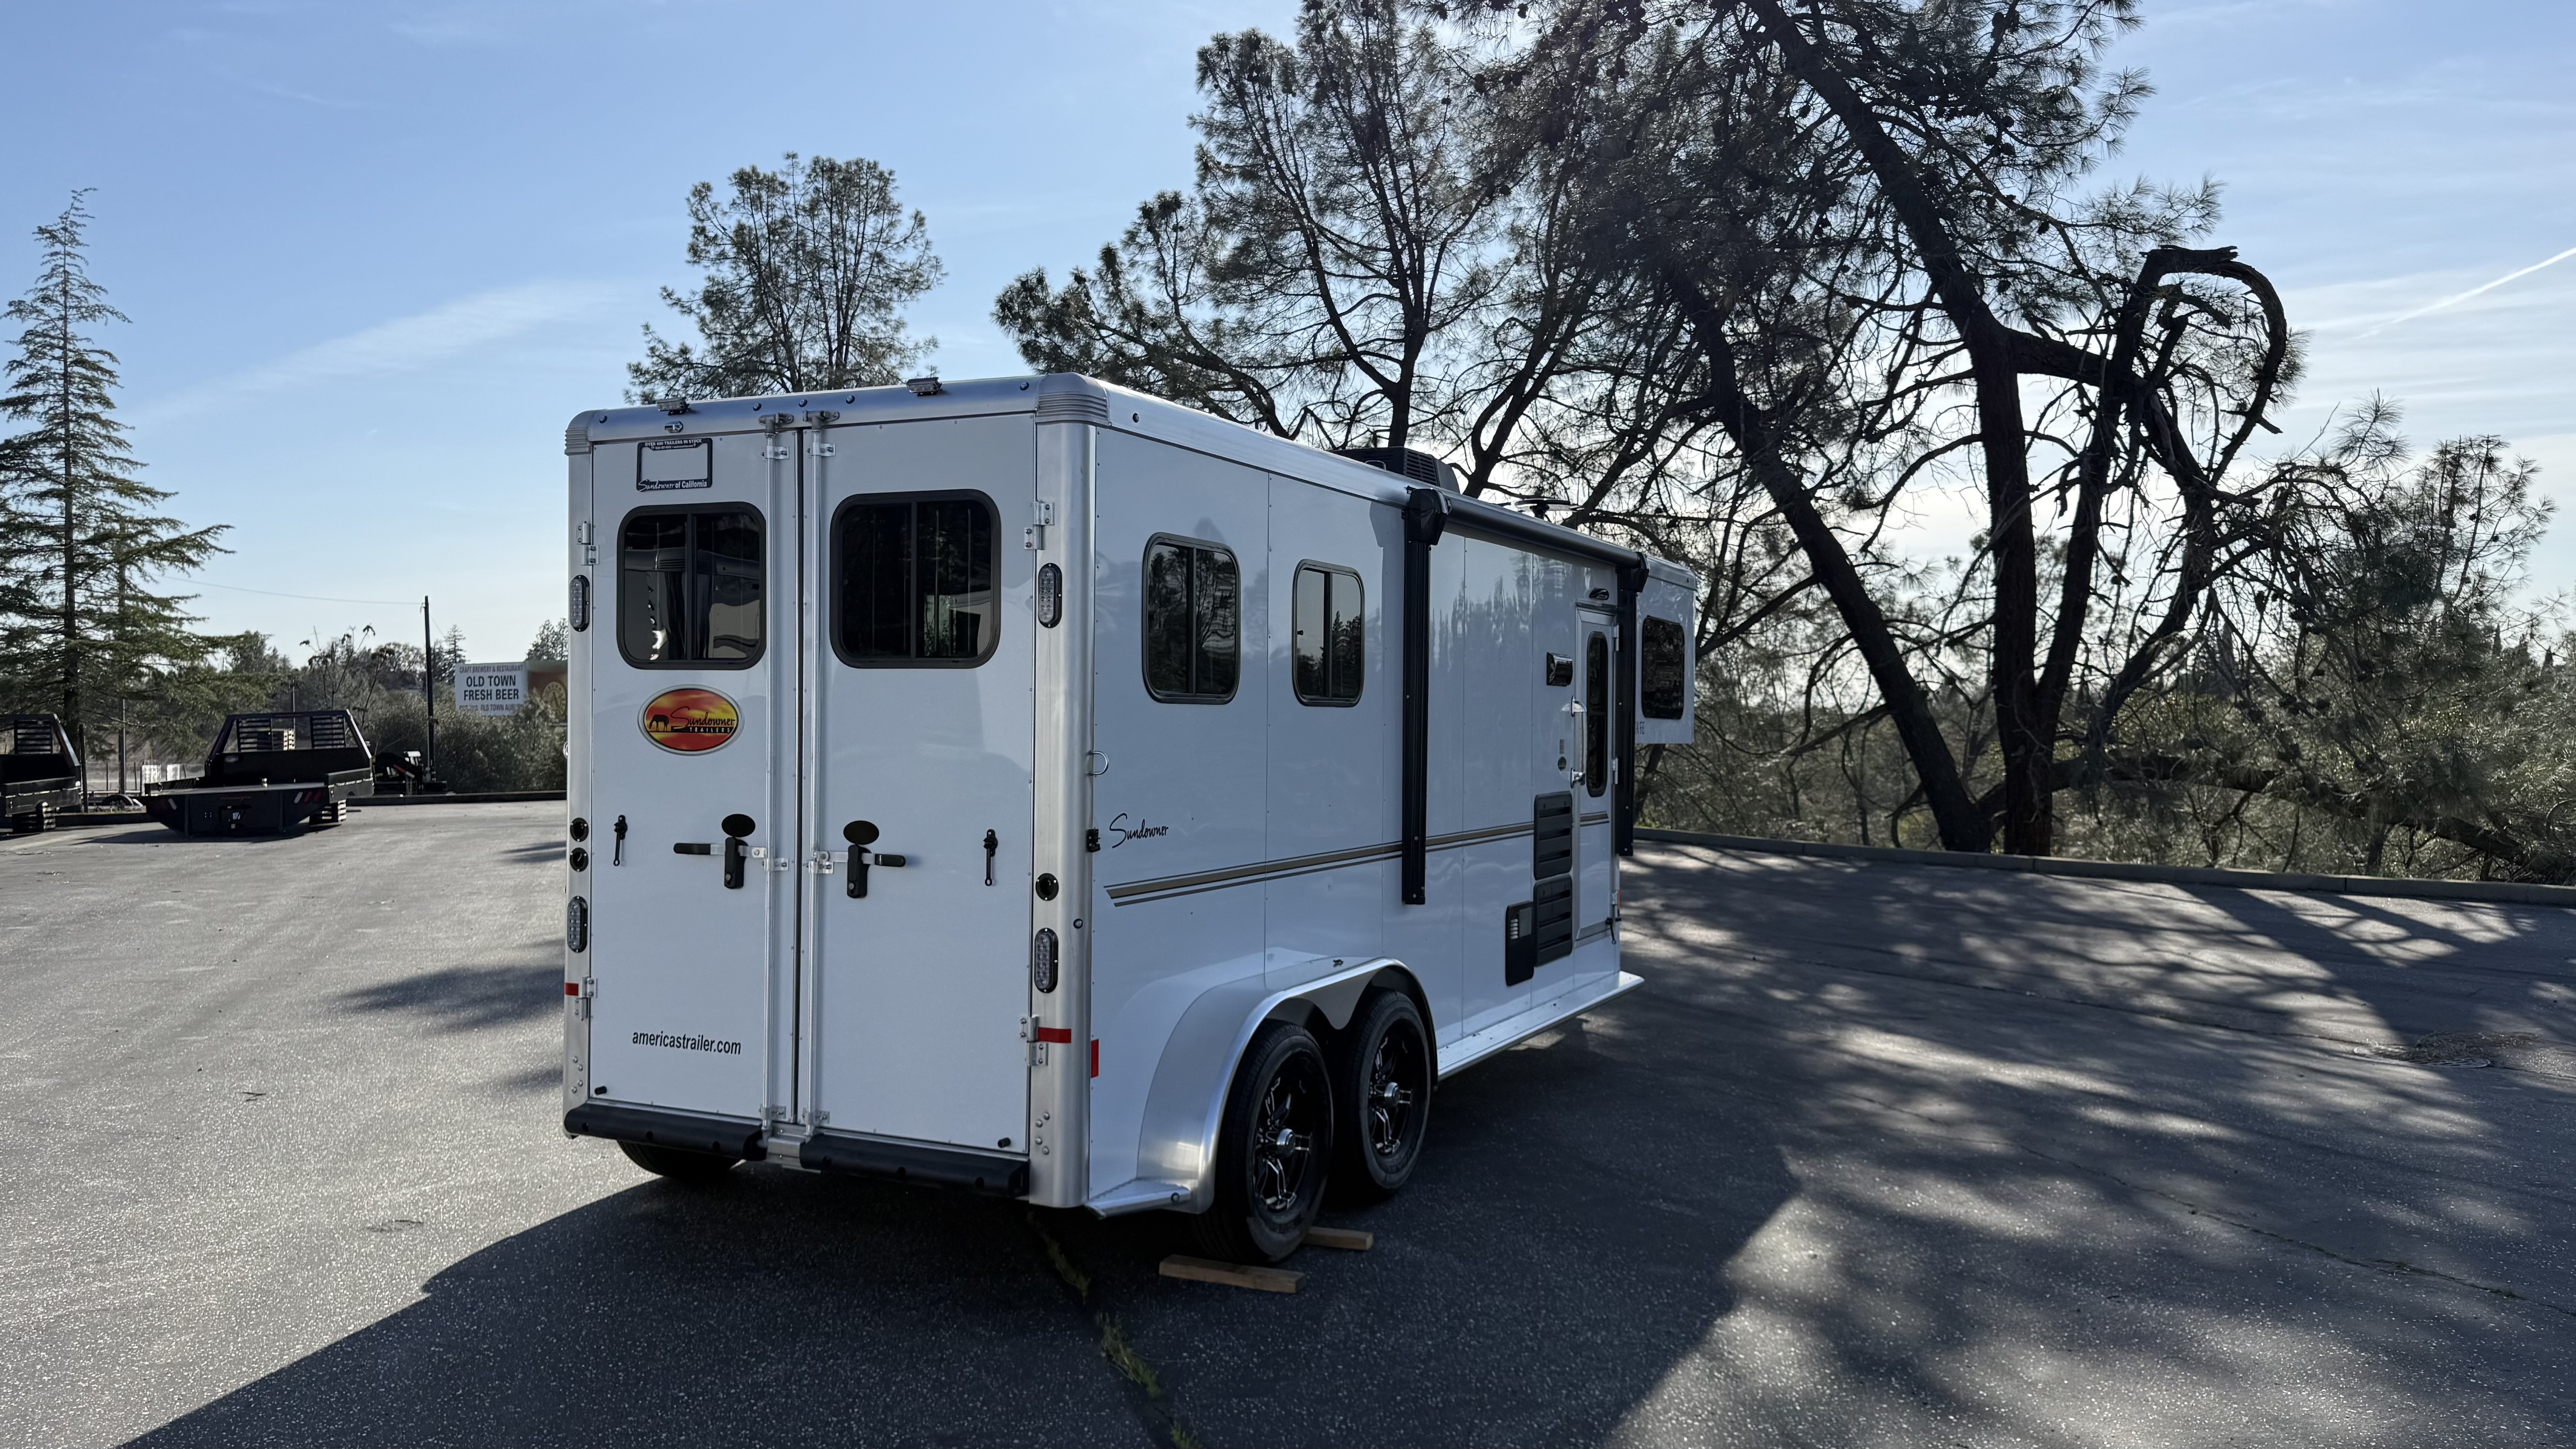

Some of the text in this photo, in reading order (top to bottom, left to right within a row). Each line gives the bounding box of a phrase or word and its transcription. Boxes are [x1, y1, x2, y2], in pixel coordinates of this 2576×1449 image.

[638, 479, 675, 492] Sundowner
[681, 479, 707, 488] California
[466, 675, 516, 687] OLD TOWN
[464, 689, 519, 701] FRESH BEER
[670, 706, 736, 729] Sundowner
[1109, 813, 1169, 849] Sundowner
[632, 1030, 741, 1055] americastrailer.com
